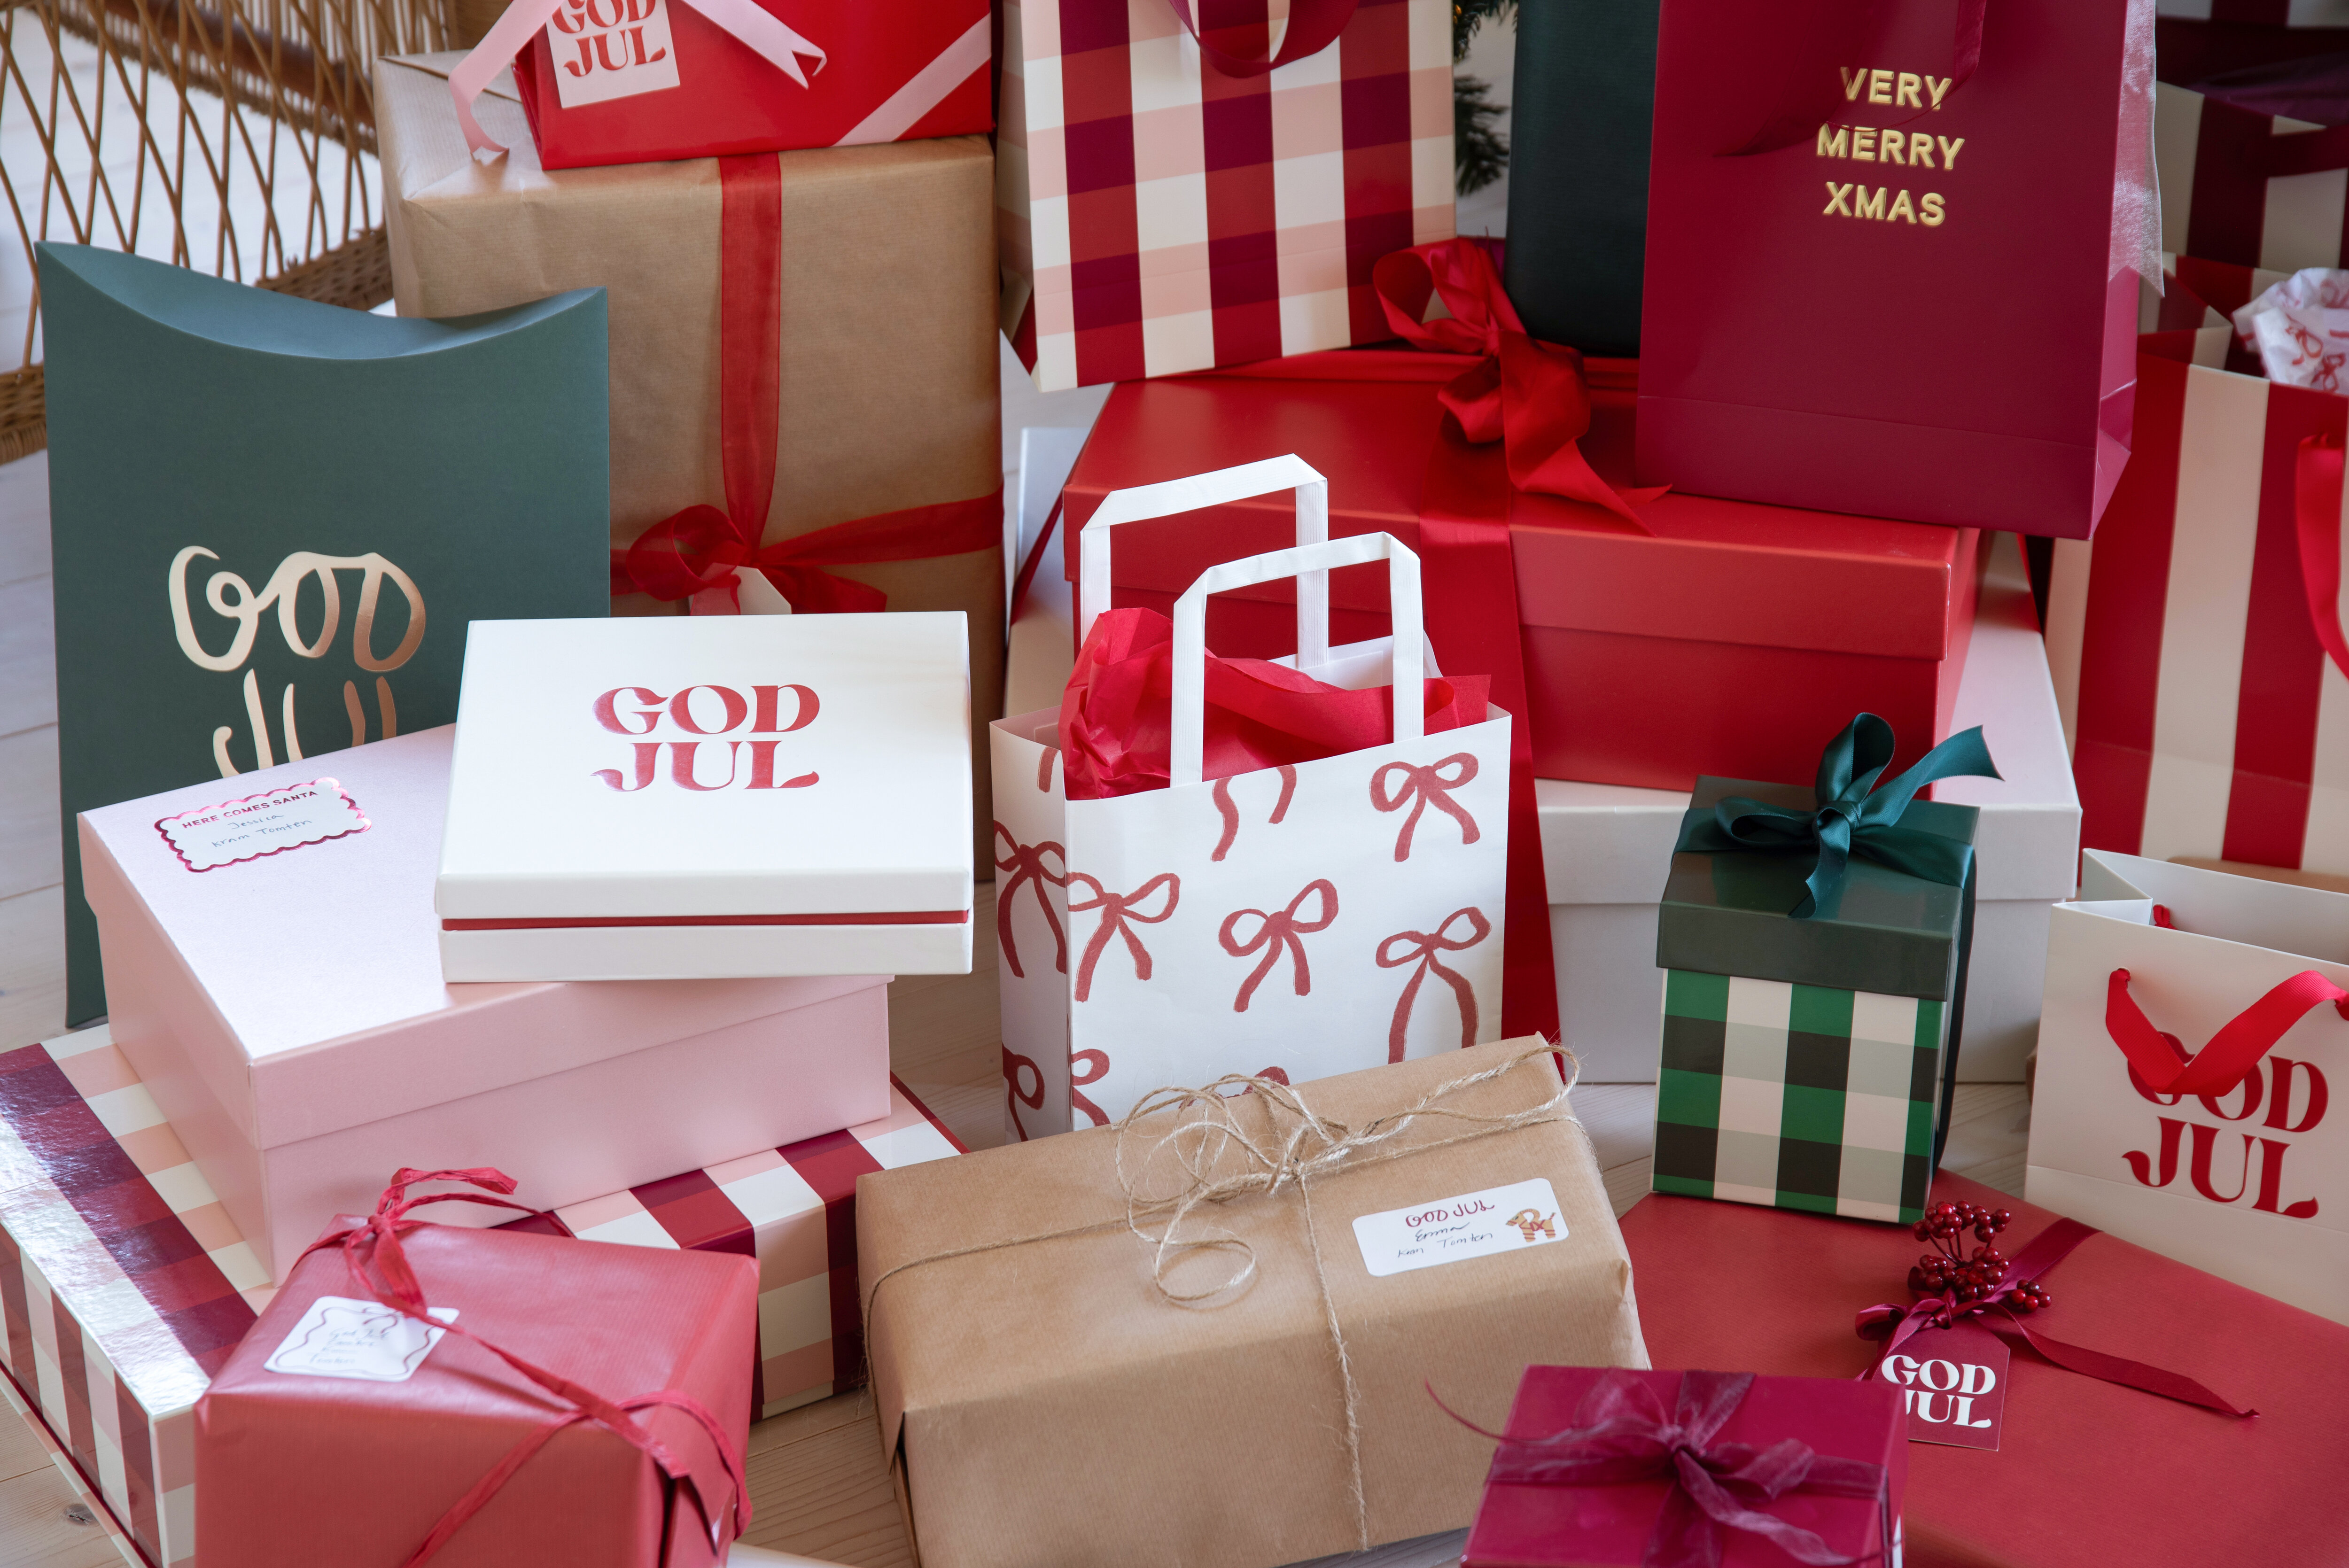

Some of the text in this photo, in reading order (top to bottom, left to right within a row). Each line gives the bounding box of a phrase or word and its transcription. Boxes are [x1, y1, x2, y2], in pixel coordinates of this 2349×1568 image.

[552, 0, 656, 34] GOD
[563, 25, 666, 77] JUL
[1840, 66, 1952, 110] VERY
[1817, 123, 1965, 170] MERRY
[1823, 181, 1945, 225] XMAS
[169, 545, 426, 671] GOD
[591, 684, 820, 735] GOD
[590, 740, 819, 792] JUL
[182, 791, 318, 828] HERE COMES SANTA
[227, 815, 284, 830] Jessica
[255, 820, 312, 834] Tomten
[2121, 1116, 2319, 1219] JUL
[1406, 1200, 1495, 1227] GOD JUL
[1415, 1222, 1470, 1242] Emma
[1881, 1354, 1996, 1395] GOD
